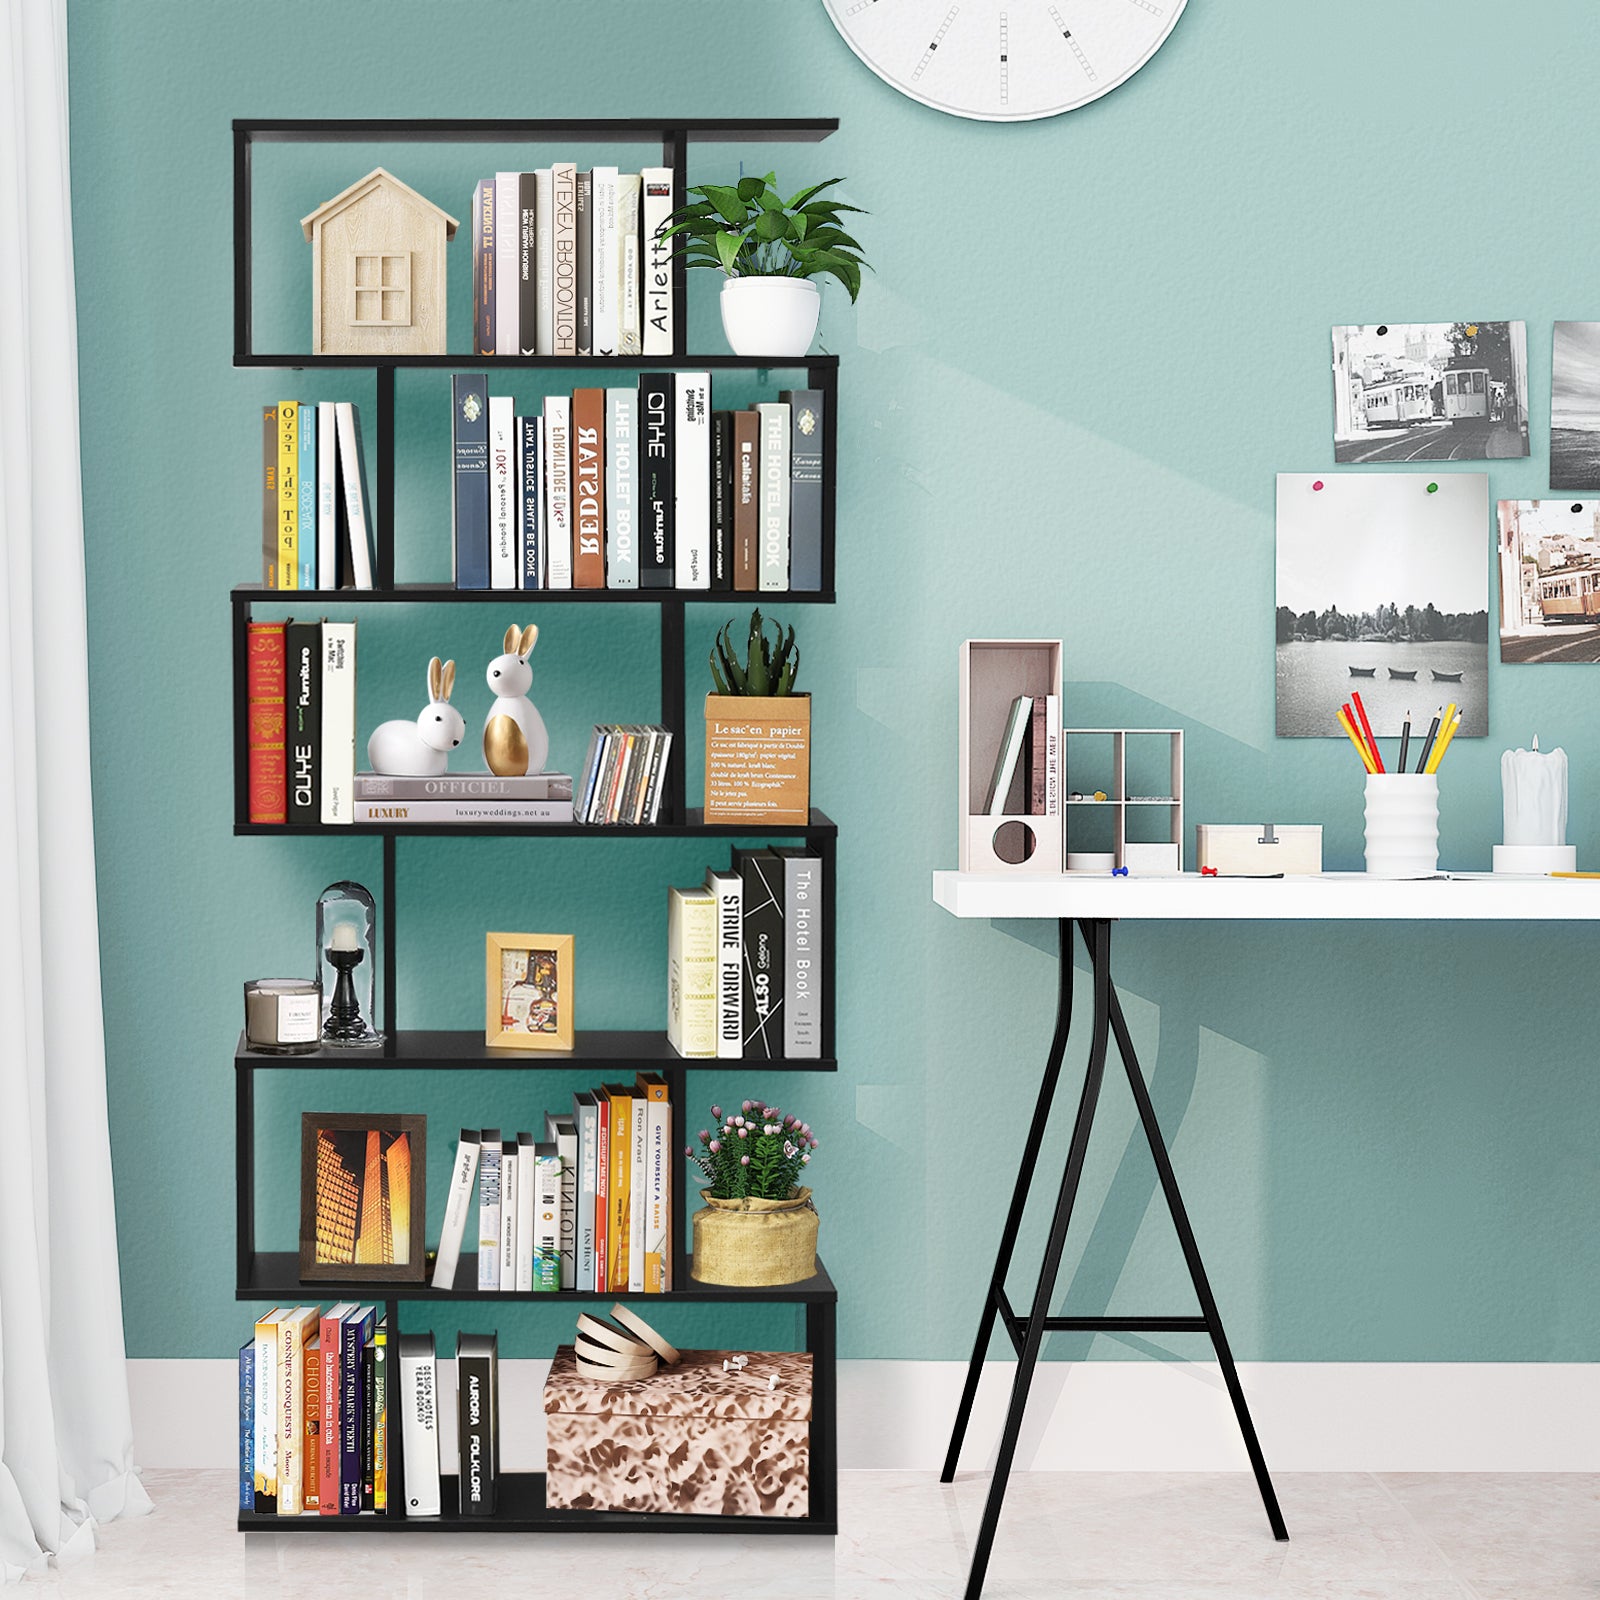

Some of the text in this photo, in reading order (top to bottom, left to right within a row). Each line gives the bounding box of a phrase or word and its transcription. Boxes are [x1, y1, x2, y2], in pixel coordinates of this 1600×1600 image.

[766, 415, 782, 568] THE HOTEL BOOK
[299, 647, 311, 706] Furniture
[327, 650, 336, 663] Mac
[336, 639, 345, 670] Switching
[714, 723, 729, 735] Le
[749, 726, 763, 735] en
[769, 725, 802, 738] papier
[368, 807, 410, 819] LUXURY
[424, 777, 510, 794] OFFICIEL
[540, 810, 551, 818] au
[796, 870, 811, 1000] The Hotel Book
[722, 895, 740, 1041] STRIVE FORWARD
[755, 973, 770, 1016] ALSO
[583, 1116, 595, 1193] STEAM
[599, 1126, 607, 1198] #DISRUPTMENOW
[636, 1107, 644, 1164] Ron Arad
[583, 1228, 592, 1273] IAN HUNT
[284, 1330, 292, 1440] CONNIE'S CONQUESTS
[306, 1356, 320, 1418] CHOICES
[325, 1351, 335, 1445] the handsomest man in cuba
[346, 1328, 355, 1453] MYSTERY AT SHARK'S TEETH
[415, 1365, 424, 1387] YEAR
[423, 1364, 433, 1431] DESIGN HOTELS
[284, 1450, 292, 1478] Moore
[469, 1375, 481, 1502] AURORA FOLKLORE
